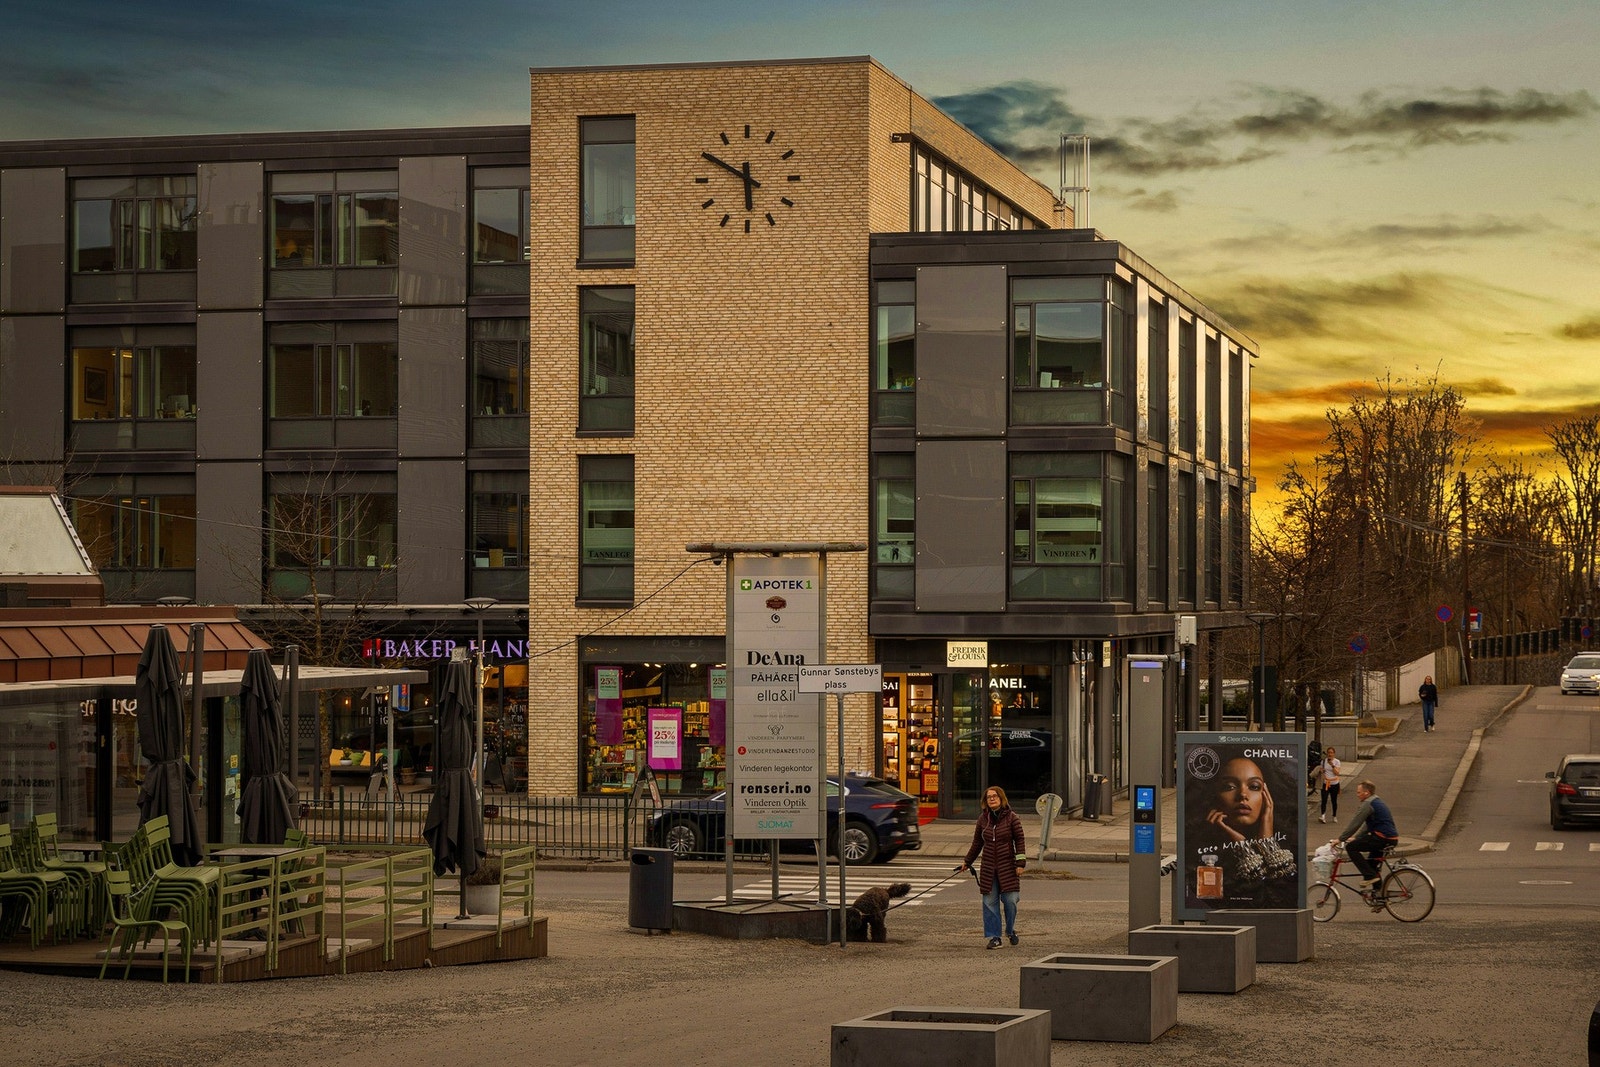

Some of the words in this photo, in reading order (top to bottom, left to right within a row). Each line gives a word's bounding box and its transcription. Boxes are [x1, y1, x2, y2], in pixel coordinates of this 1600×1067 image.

[1043, 549, 1087, 558] VINDEREN
[753, 580, 804, 590] APOTEK
[805, 580, 812, 590] 1
[385, 639, 457, 658] BAKER
[952, 646, 986, 654] FREDRIK
[746, 650, 805, 666] DeAna
[800, 667, 831, 676] Gunnar
[834, 667, 879, 677] Sønstebys
[824, 680, 847, 689] plass
[654, 730, 676, 740] 25%
[1243, 749, 1293, 758] CHANEL
[739, 764, 773, 772] Vinderen
[774, 764, 813, 774] legekontor
[740, 781, 812, 794] renseri.no
[744, 798, 781, 807] Vinderen
[783, 798, 807, 809] Optik
